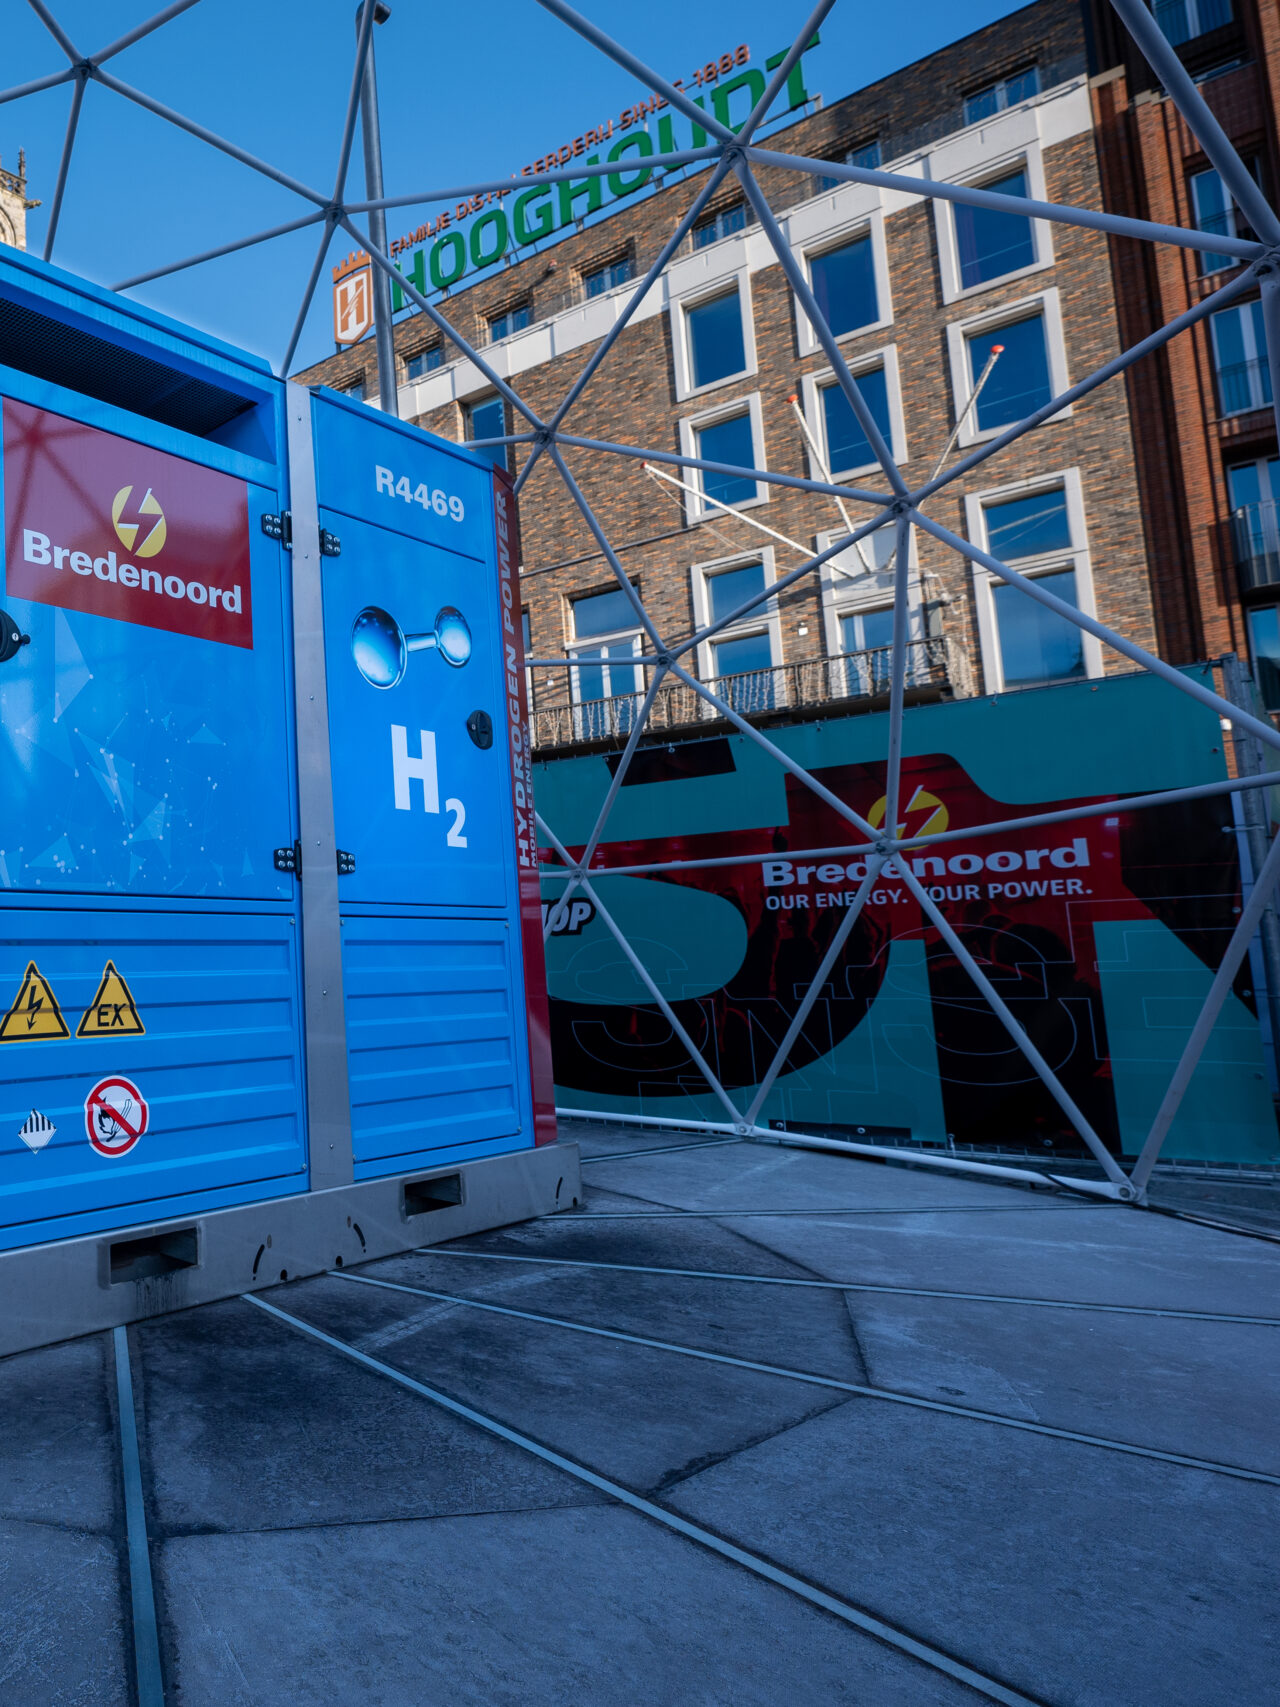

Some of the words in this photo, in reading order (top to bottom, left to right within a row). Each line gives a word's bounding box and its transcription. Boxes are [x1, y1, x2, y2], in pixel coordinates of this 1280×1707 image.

[389, 211, 451, 257] FAMILIE
[693, 44, 750, 88] 1888
[392, 31, 821, 313] HOOGHOUDT
[375, 464, 465, 523] R4469
[23, 528, 243, 615] Bredenoord
[496, 491, 515, 635] POWER
[390, 724, 468, 849] H2
[506, 644, 530, 868] HYDROGEN
[528, 806, 537, 868] MOBILE
[762, 838, 1091, 887] Bredenoord
[766, 894, 810, 911] OUR
[988, 878, 1094, 900] POWER.
[97, 1003, 127, 1027] EX
